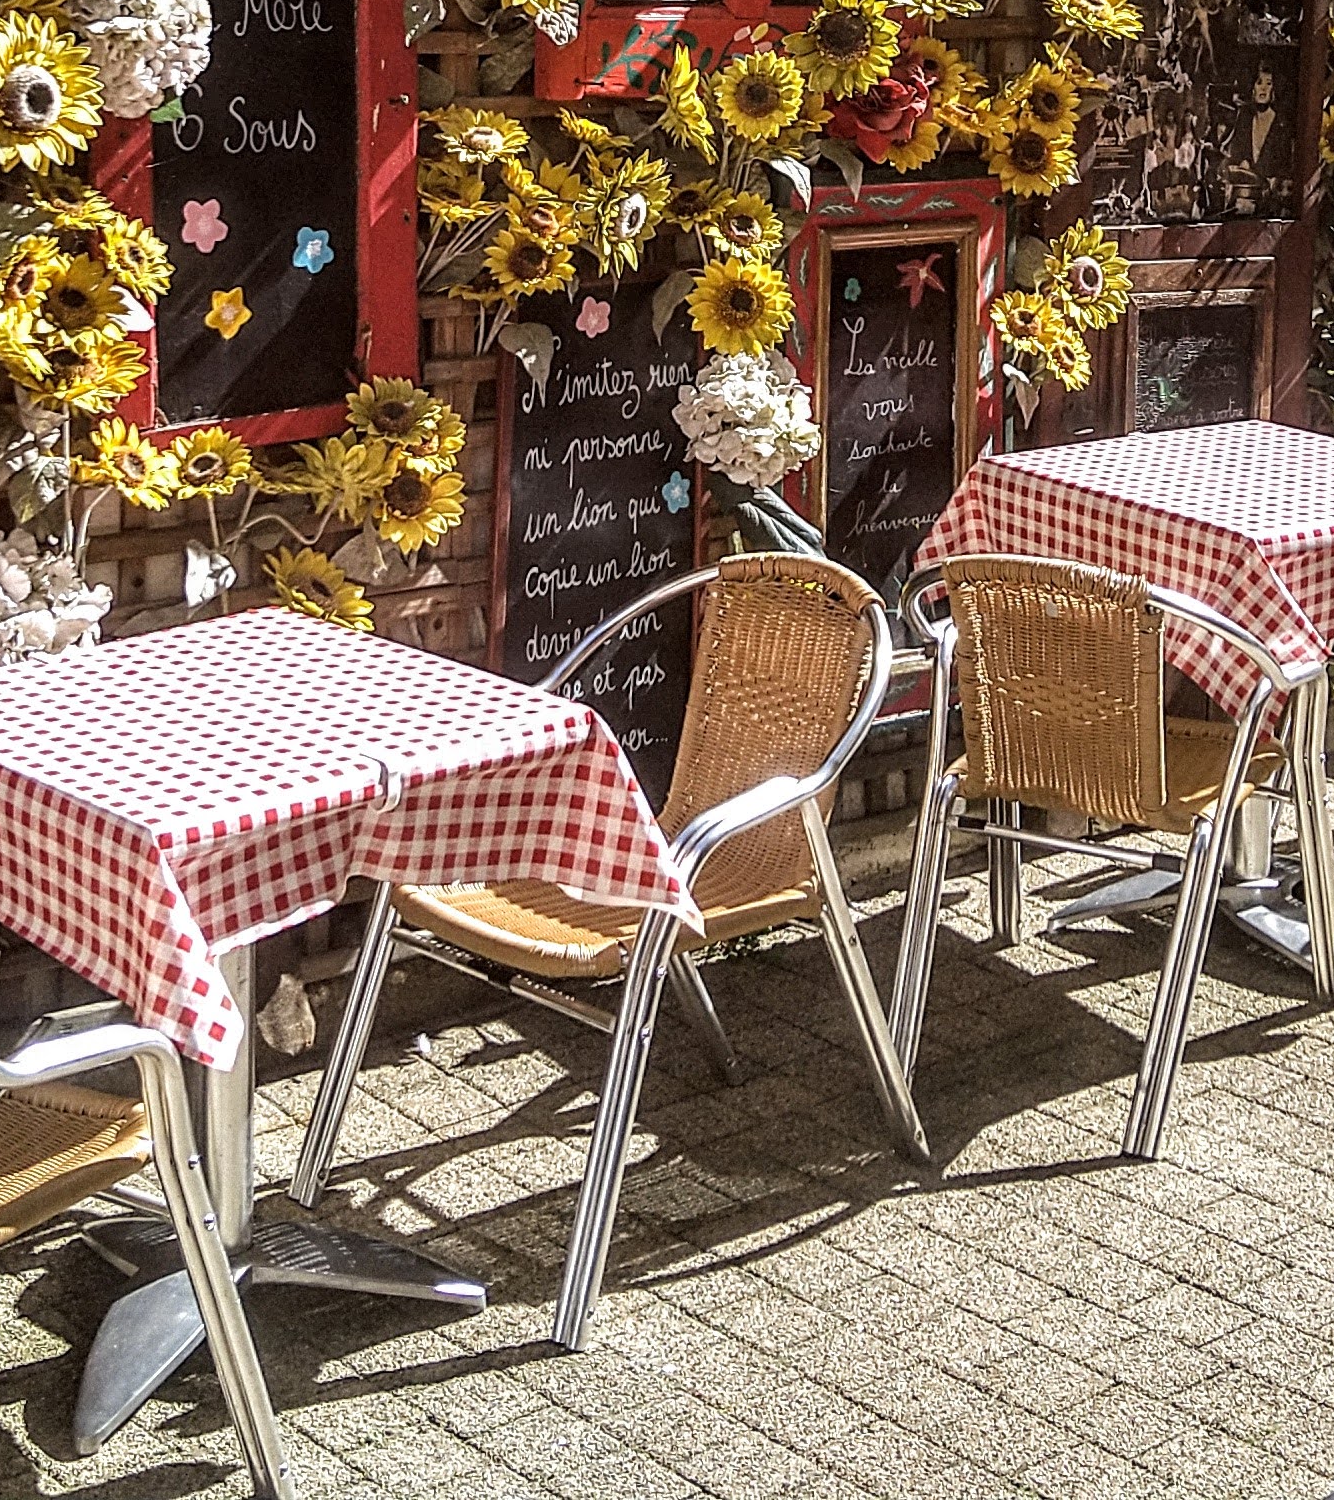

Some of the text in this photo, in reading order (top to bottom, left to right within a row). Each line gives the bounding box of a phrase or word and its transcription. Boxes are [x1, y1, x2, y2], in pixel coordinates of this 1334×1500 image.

[223, 96, 317, 154] Sous
[841, 315, 939, 376] La vieille
[645, 351, 694, 393] rien
[862, 393, 915, 421] vous
[523, 437, 553, 471] ni
[878, 468, 904, 494] la
[523, 485, 662, 545] un lion qui
[584, 556, 623, 587] un
[625, 540, 677, 580] lion
[619, 611, 663, 641] un
[593, 660, 617, 696] et
[622, 661, 667, 711] pas
